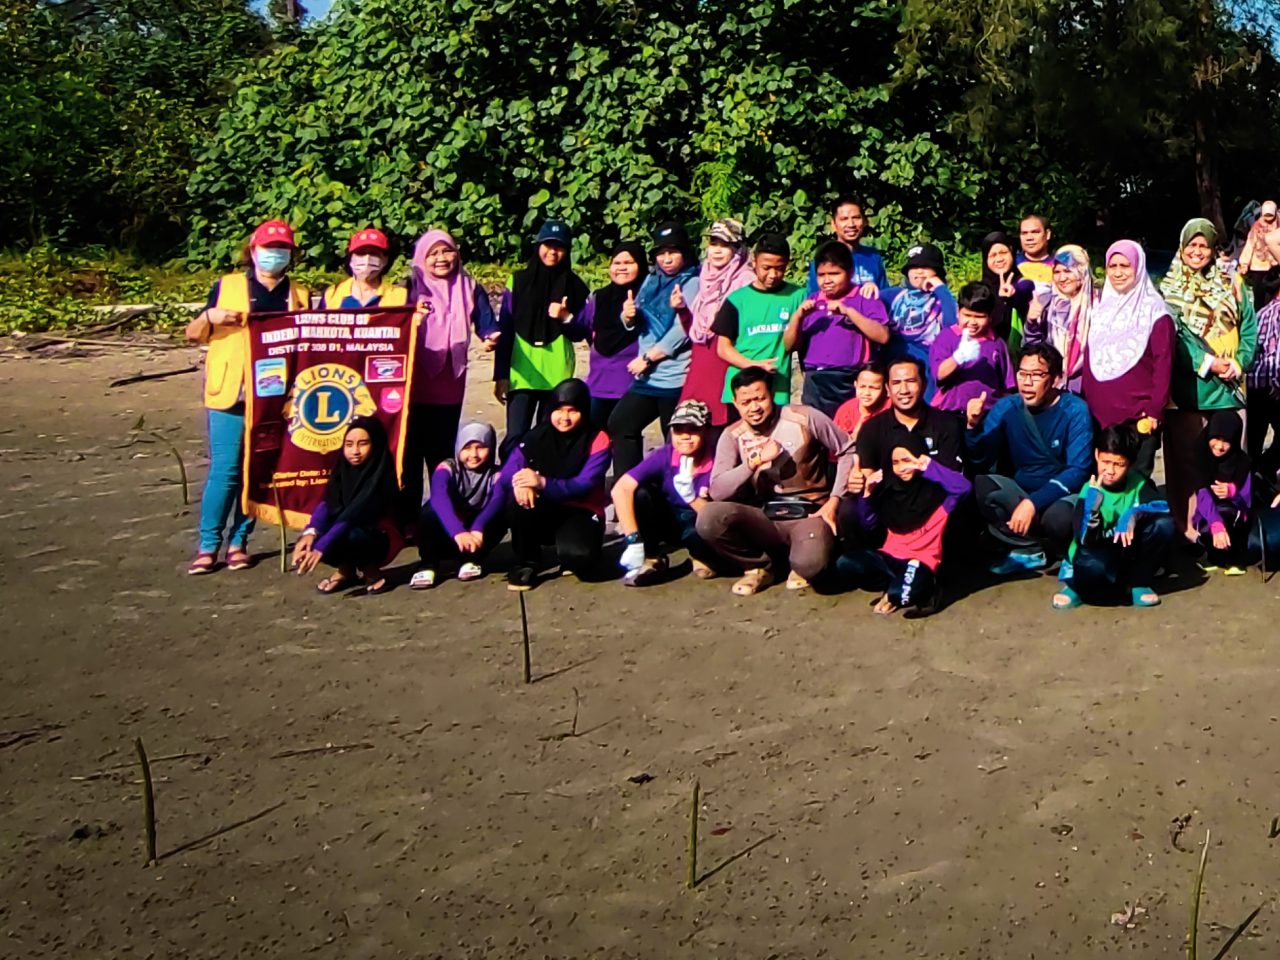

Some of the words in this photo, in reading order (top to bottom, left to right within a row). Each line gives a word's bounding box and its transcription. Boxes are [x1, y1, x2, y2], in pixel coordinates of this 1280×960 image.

[295, 313, 326, 325] LIONS
[328, 314, 354, 325] CLUB
[356, 314, 370, 325] OF
[353, 327, 401, 339] KUANTAN
[346, 343, 394, 352] MALAYSIA
[301, 367, 356, 386] LIONS
[314, 392, 340, 423] L
